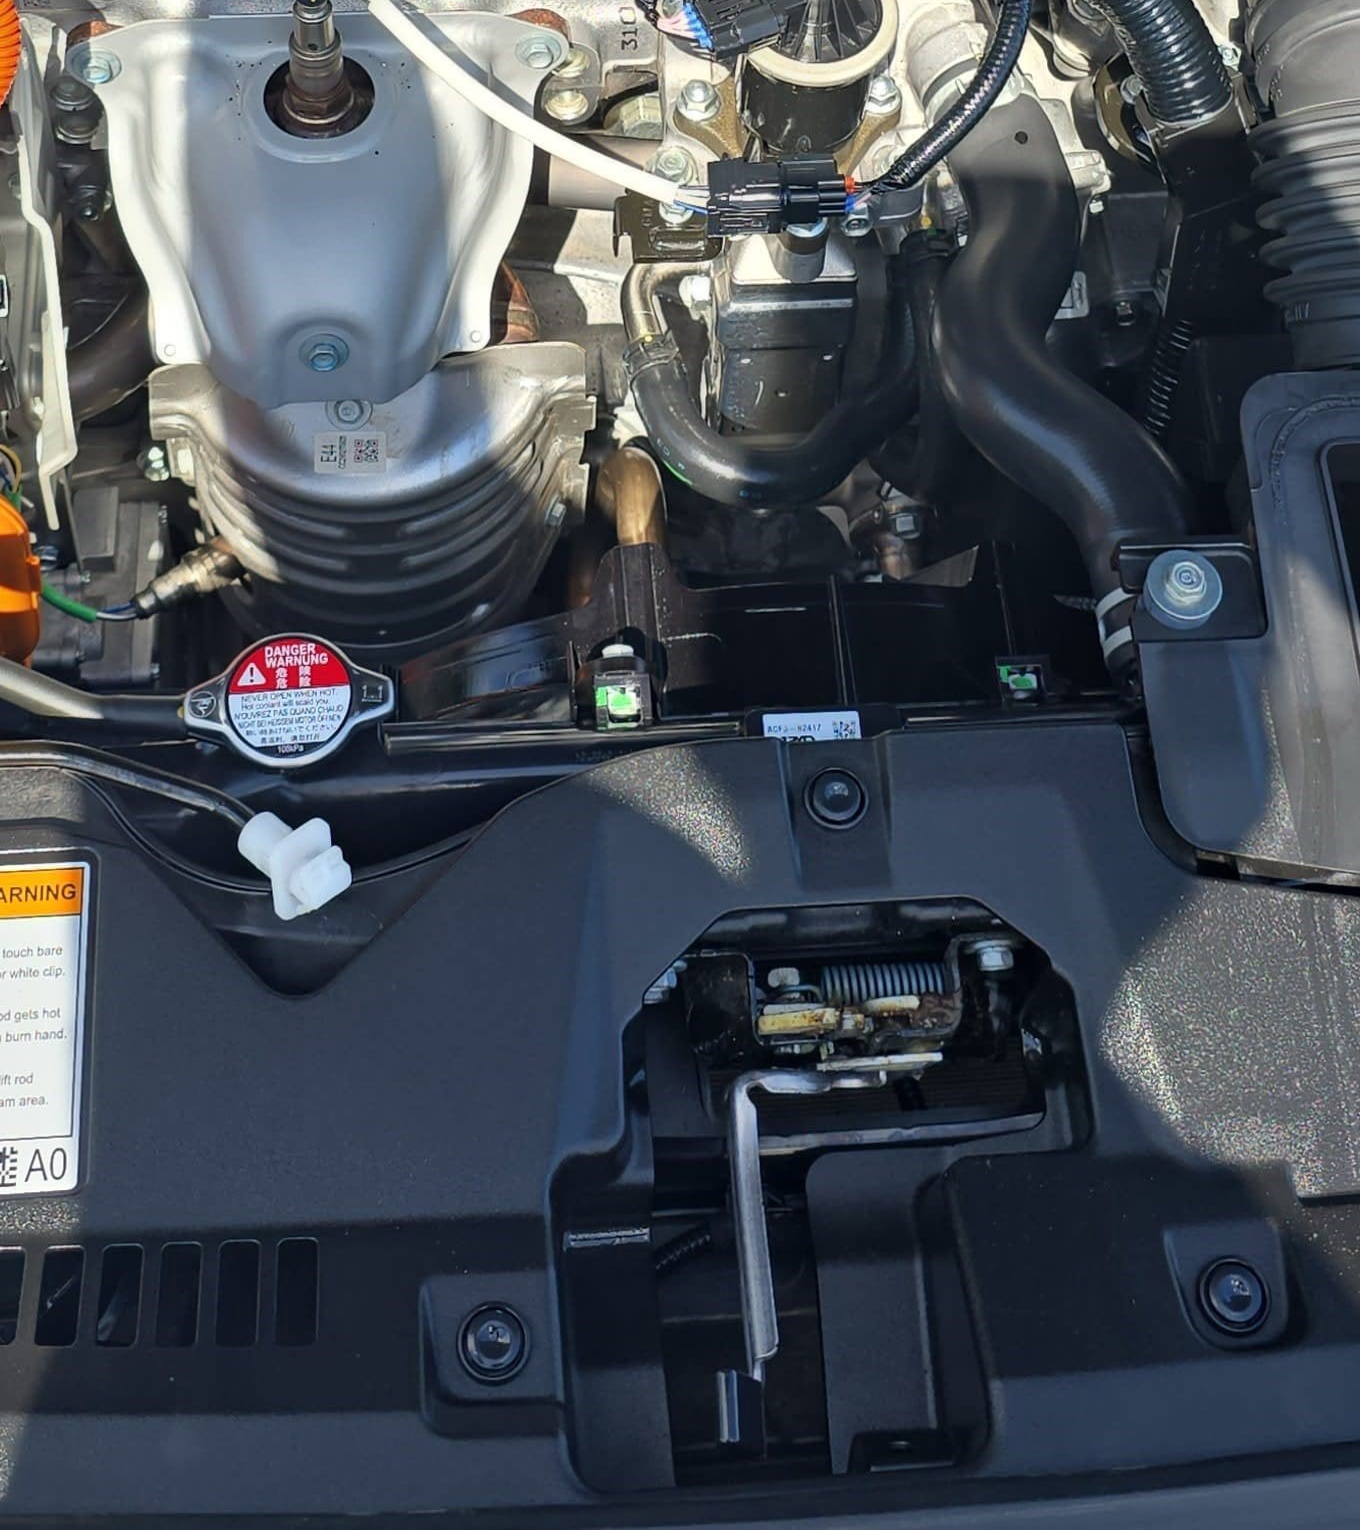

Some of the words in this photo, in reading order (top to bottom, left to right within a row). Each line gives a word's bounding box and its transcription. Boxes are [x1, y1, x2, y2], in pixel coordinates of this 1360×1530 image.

[619, 7, 638, 50] 310
[264, 643, 316, 657] DANGER
[265, 653, 329, 668] WARNUNG
[241, 693, 268, 702] NEVER
[270, 691, 292, 700] OPEN
[295, 689, 318, 698] WHEN
[273, 709, 288, 717] PAS
[290, 707, 316, 716] QUAND
[2, 946, 34, 959] touch
[37, 945, 63, 957] bare
[10, 967, 40, 979] white
[42, 965, 66, 981] clip.
[14, 1009, 39, 1023] gets
[42, 1007, 61, 1019] hot
[4, 1029, 31, 1043] burn
[35, 1027, 67, 1041] hand.
[14, 1073, 34, 1085] rod
[19, 1095, 49, 1107] area.
[25, 1147, 68, 1182] A0
